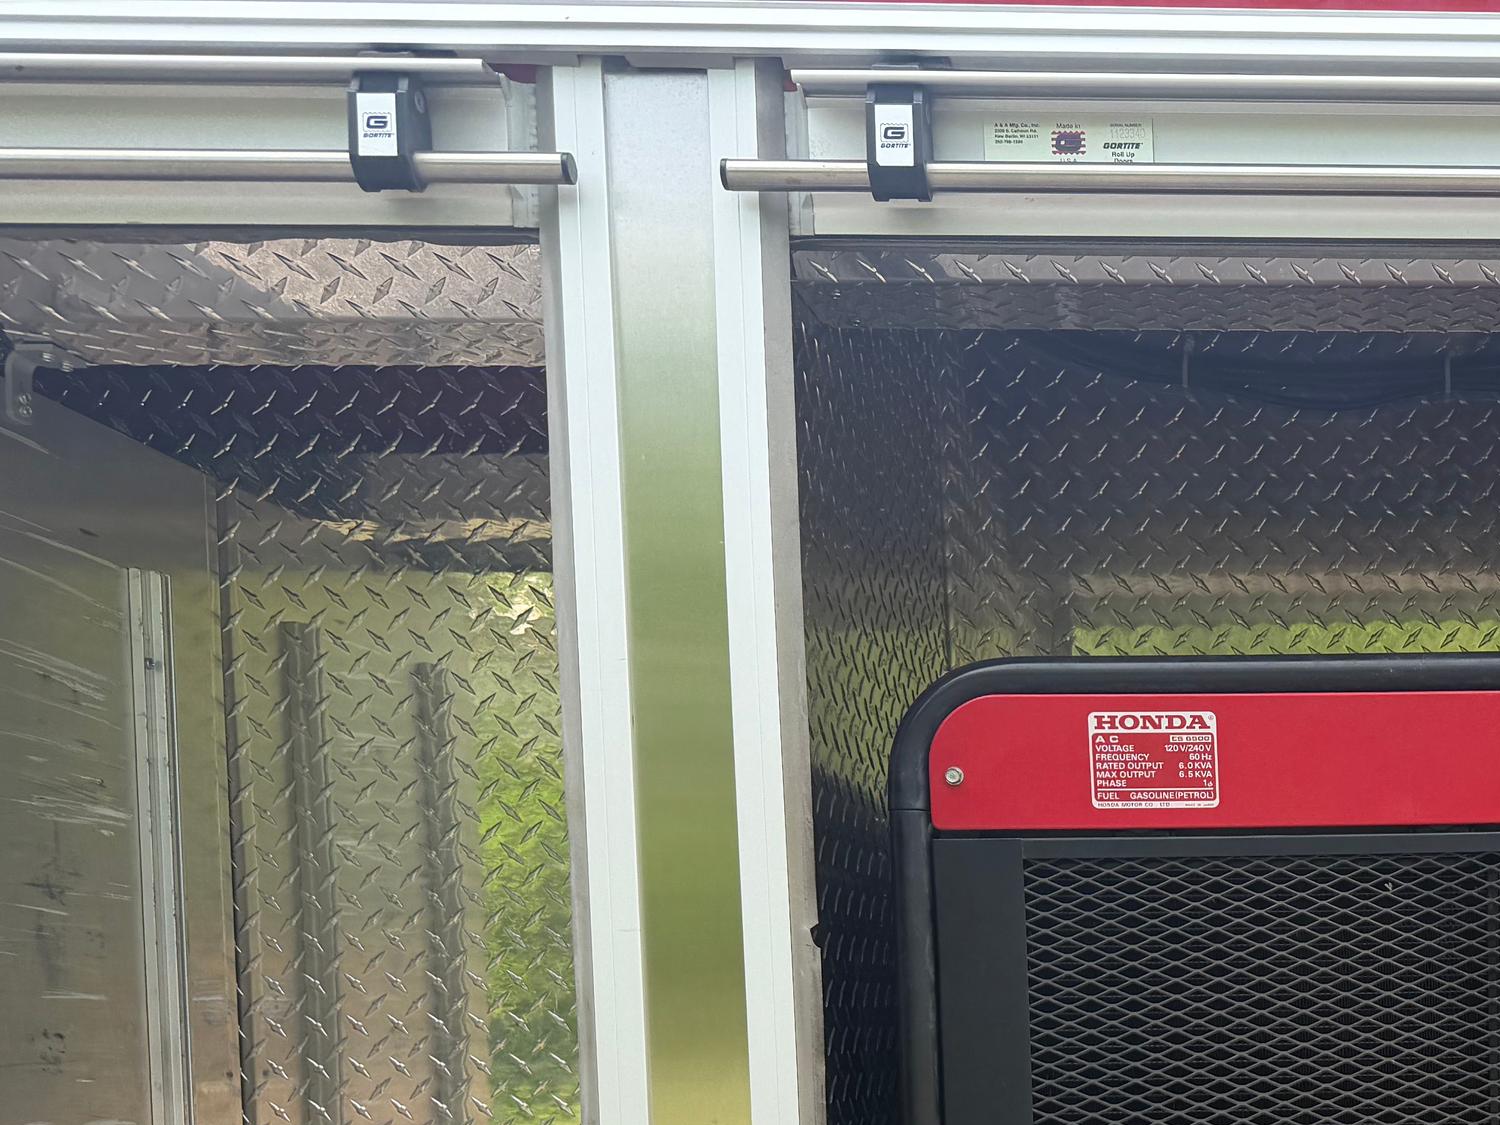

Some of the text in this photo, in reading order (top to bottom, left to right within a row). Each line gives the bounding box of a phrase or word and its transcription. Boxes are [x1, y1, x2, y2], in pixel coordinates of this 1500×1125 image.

[1125, 151, 1135, 159] Up
[1093, 714, 1211, 730] HONDA
[1095, 744, 1135, 752] VOLTAGE
[1095, 753, 1150, 761] FREQUENCY
[1096, 762, 1164, 770] RATED OUTPUT
[1096, 779, 1127, 787] PHASE
[1097, 792, 1120, 800] FUEL
